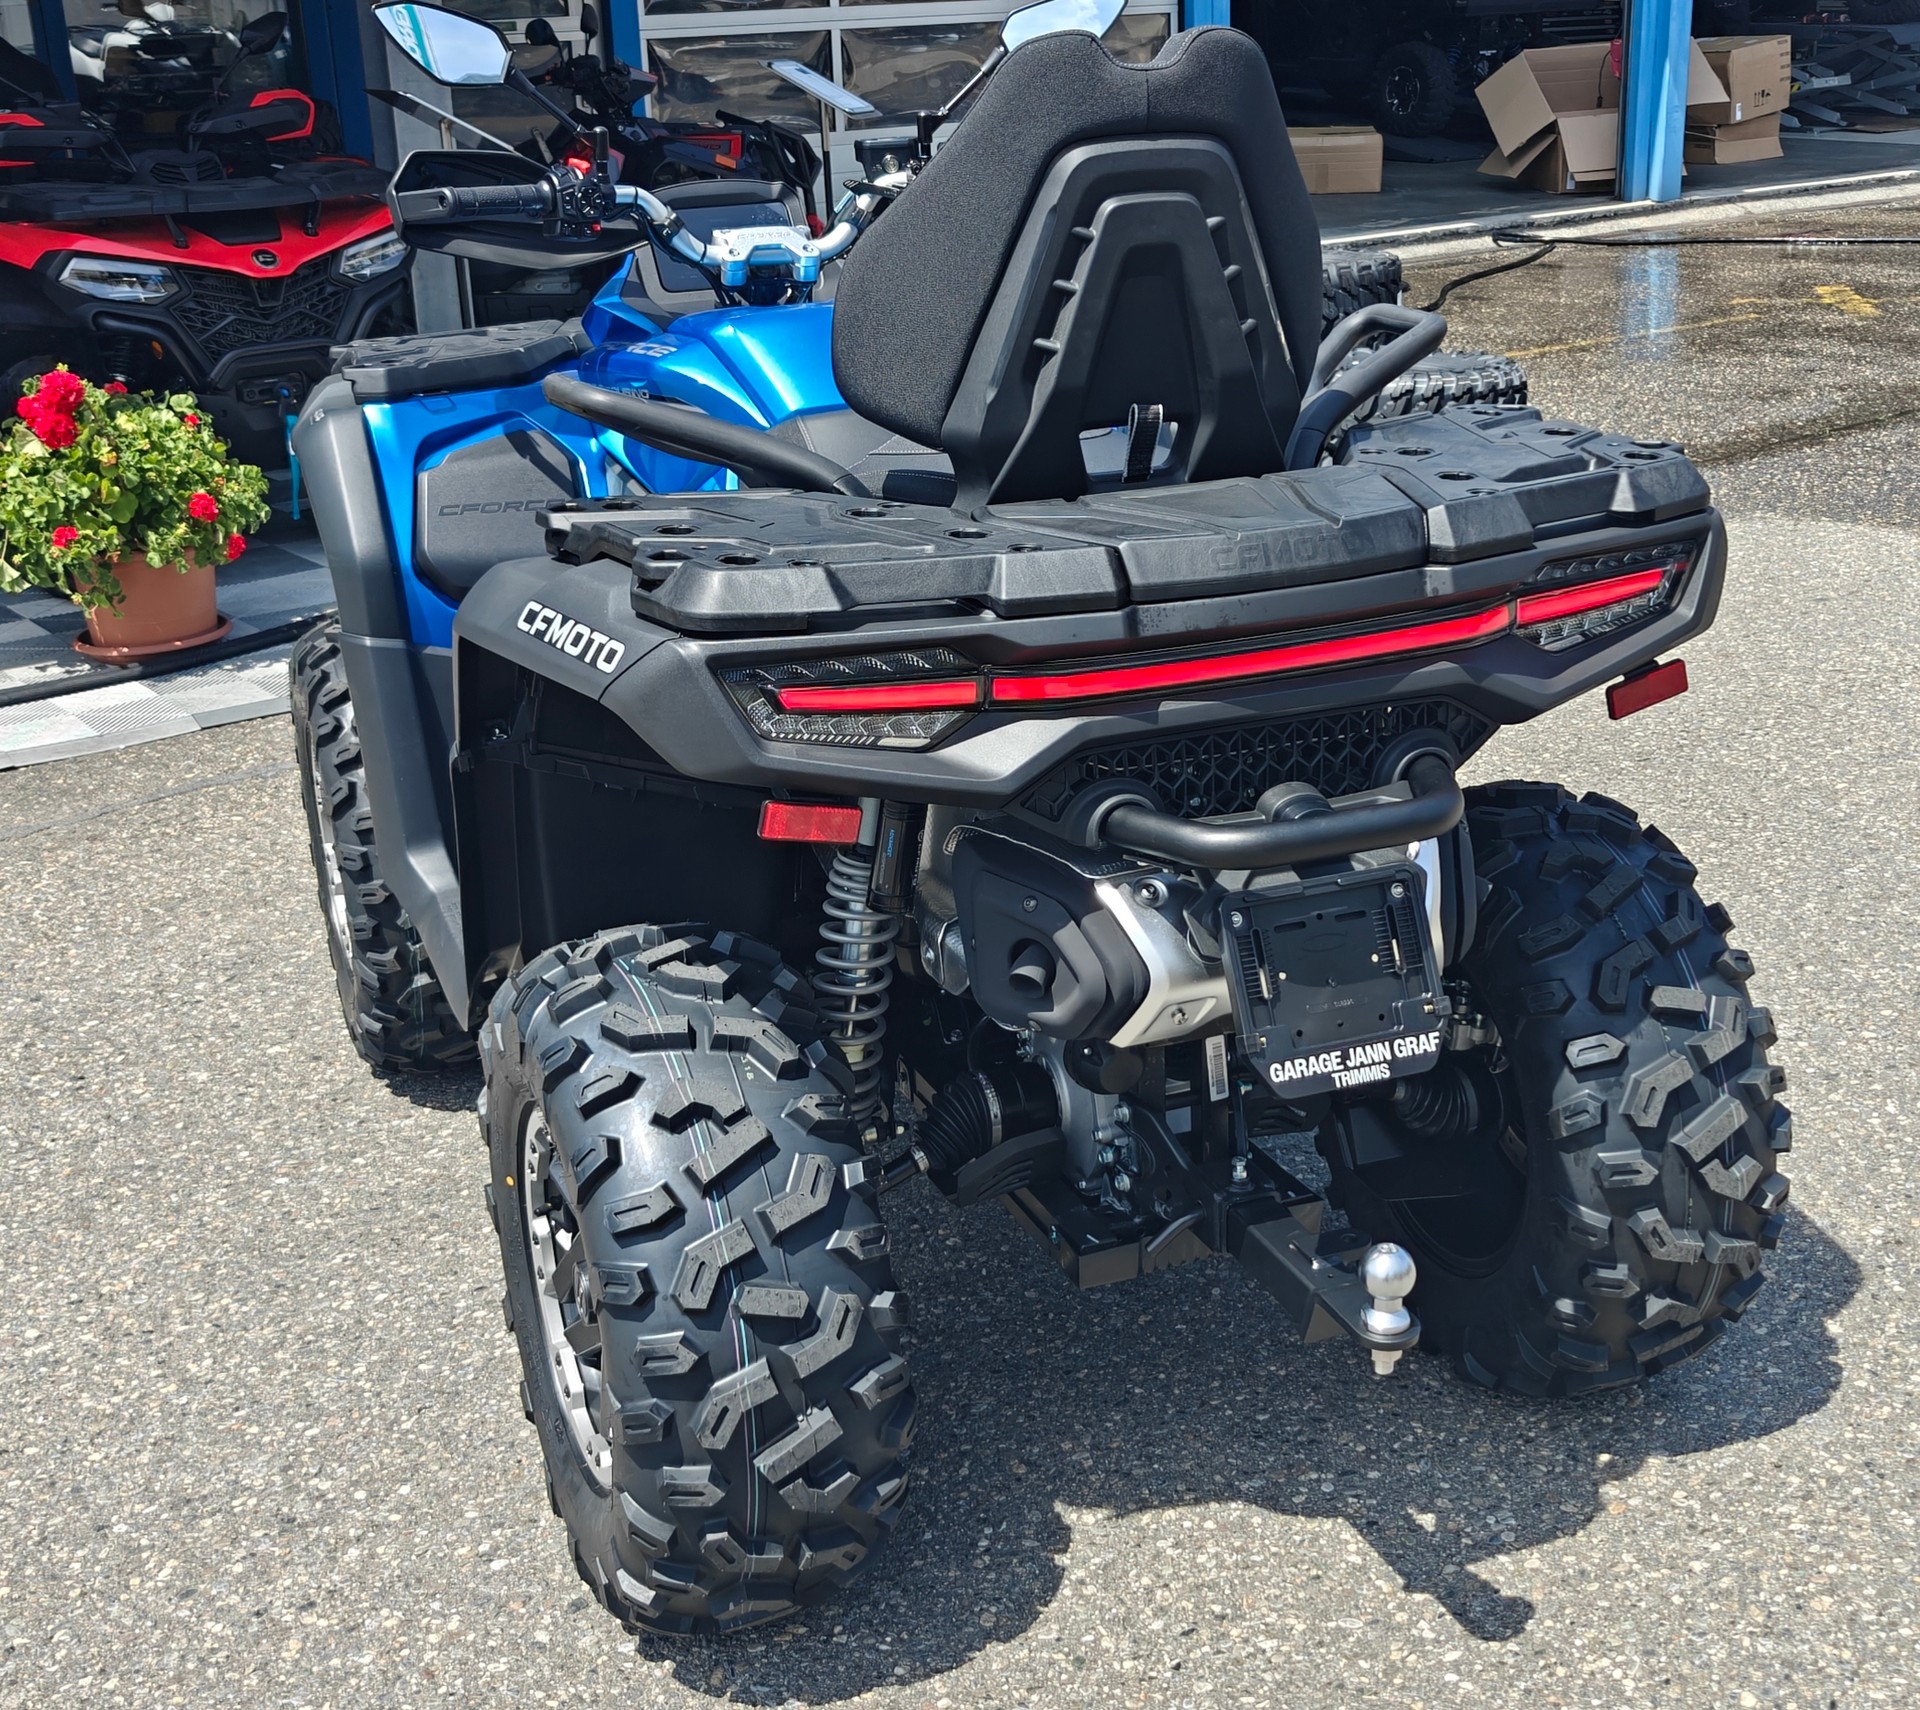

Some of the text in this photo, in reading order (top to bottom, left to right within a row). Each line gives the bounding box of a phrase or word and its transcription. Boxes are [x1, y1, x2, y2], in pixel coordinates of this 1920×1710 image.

[516, 600, 626, 674] CFMOTO
[1269, 1031, 1440, 1083] GARAGE JANN GRAF
[1331, 1063, 1391, 1089] TRIMMIS
